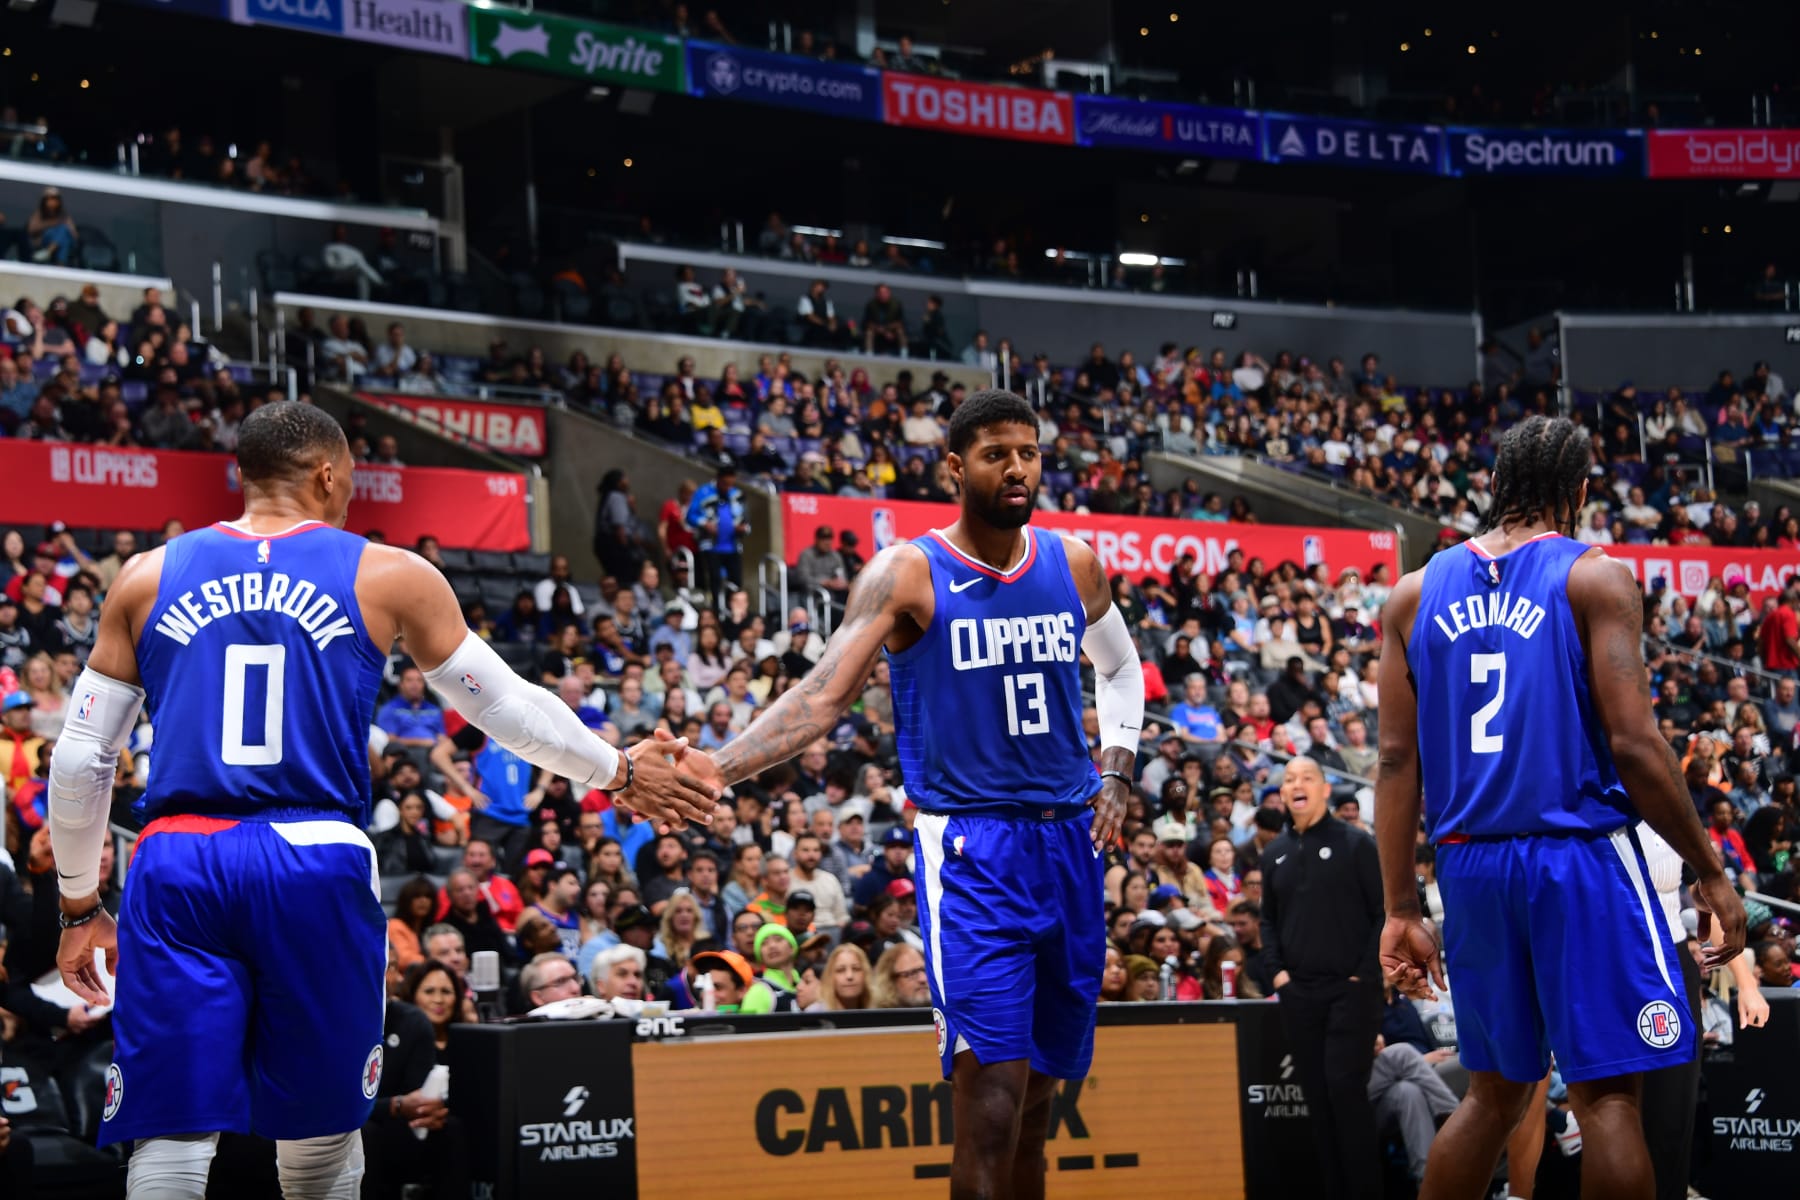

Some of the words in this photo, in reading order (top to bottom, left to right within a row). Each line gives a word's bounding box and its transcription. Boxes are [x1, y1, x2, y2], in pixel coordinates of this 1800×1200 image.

[353, 0, 453, 44] Health
[570, 31, 662, 75] Sprite
[744, 65, 863, 101] crypto.com
[890, 82, 1065, 135] TOSHIBA
[1177, 120, 1254, 146] ULTRA
[1316, 128, 1430, 164] DELTA
[1465, 134, 1616, 171] Spectrum
[1684, 135, 1800, 173] boldy
[73, 450, 159, 488] CLIPPERS
[486, 475, 518, 496] 101
[1368, 532, 1394, 551] 102
[154, 572, 355, 651] WESTBROOK
[1433, 591, 1546, 642] LEONARD
[950, 611, 1076, 671] CLIPPERS
[221, 643, 286, 766] 0
[1003, 672, 1050, 736] 13
[1470, 651, 1507, 754] 2
[635, 1016, 685, 1036] anc
[1247, 1084, 1304, 1104] STARL
[519, 1117, 635, 1146] STARLUX
[1712, 1116, 1800, 1136] STARLUX
[1730, 1137, 1793, 1152] AIRLINES
[539, 1142, 618, 1162] AIRLINES
